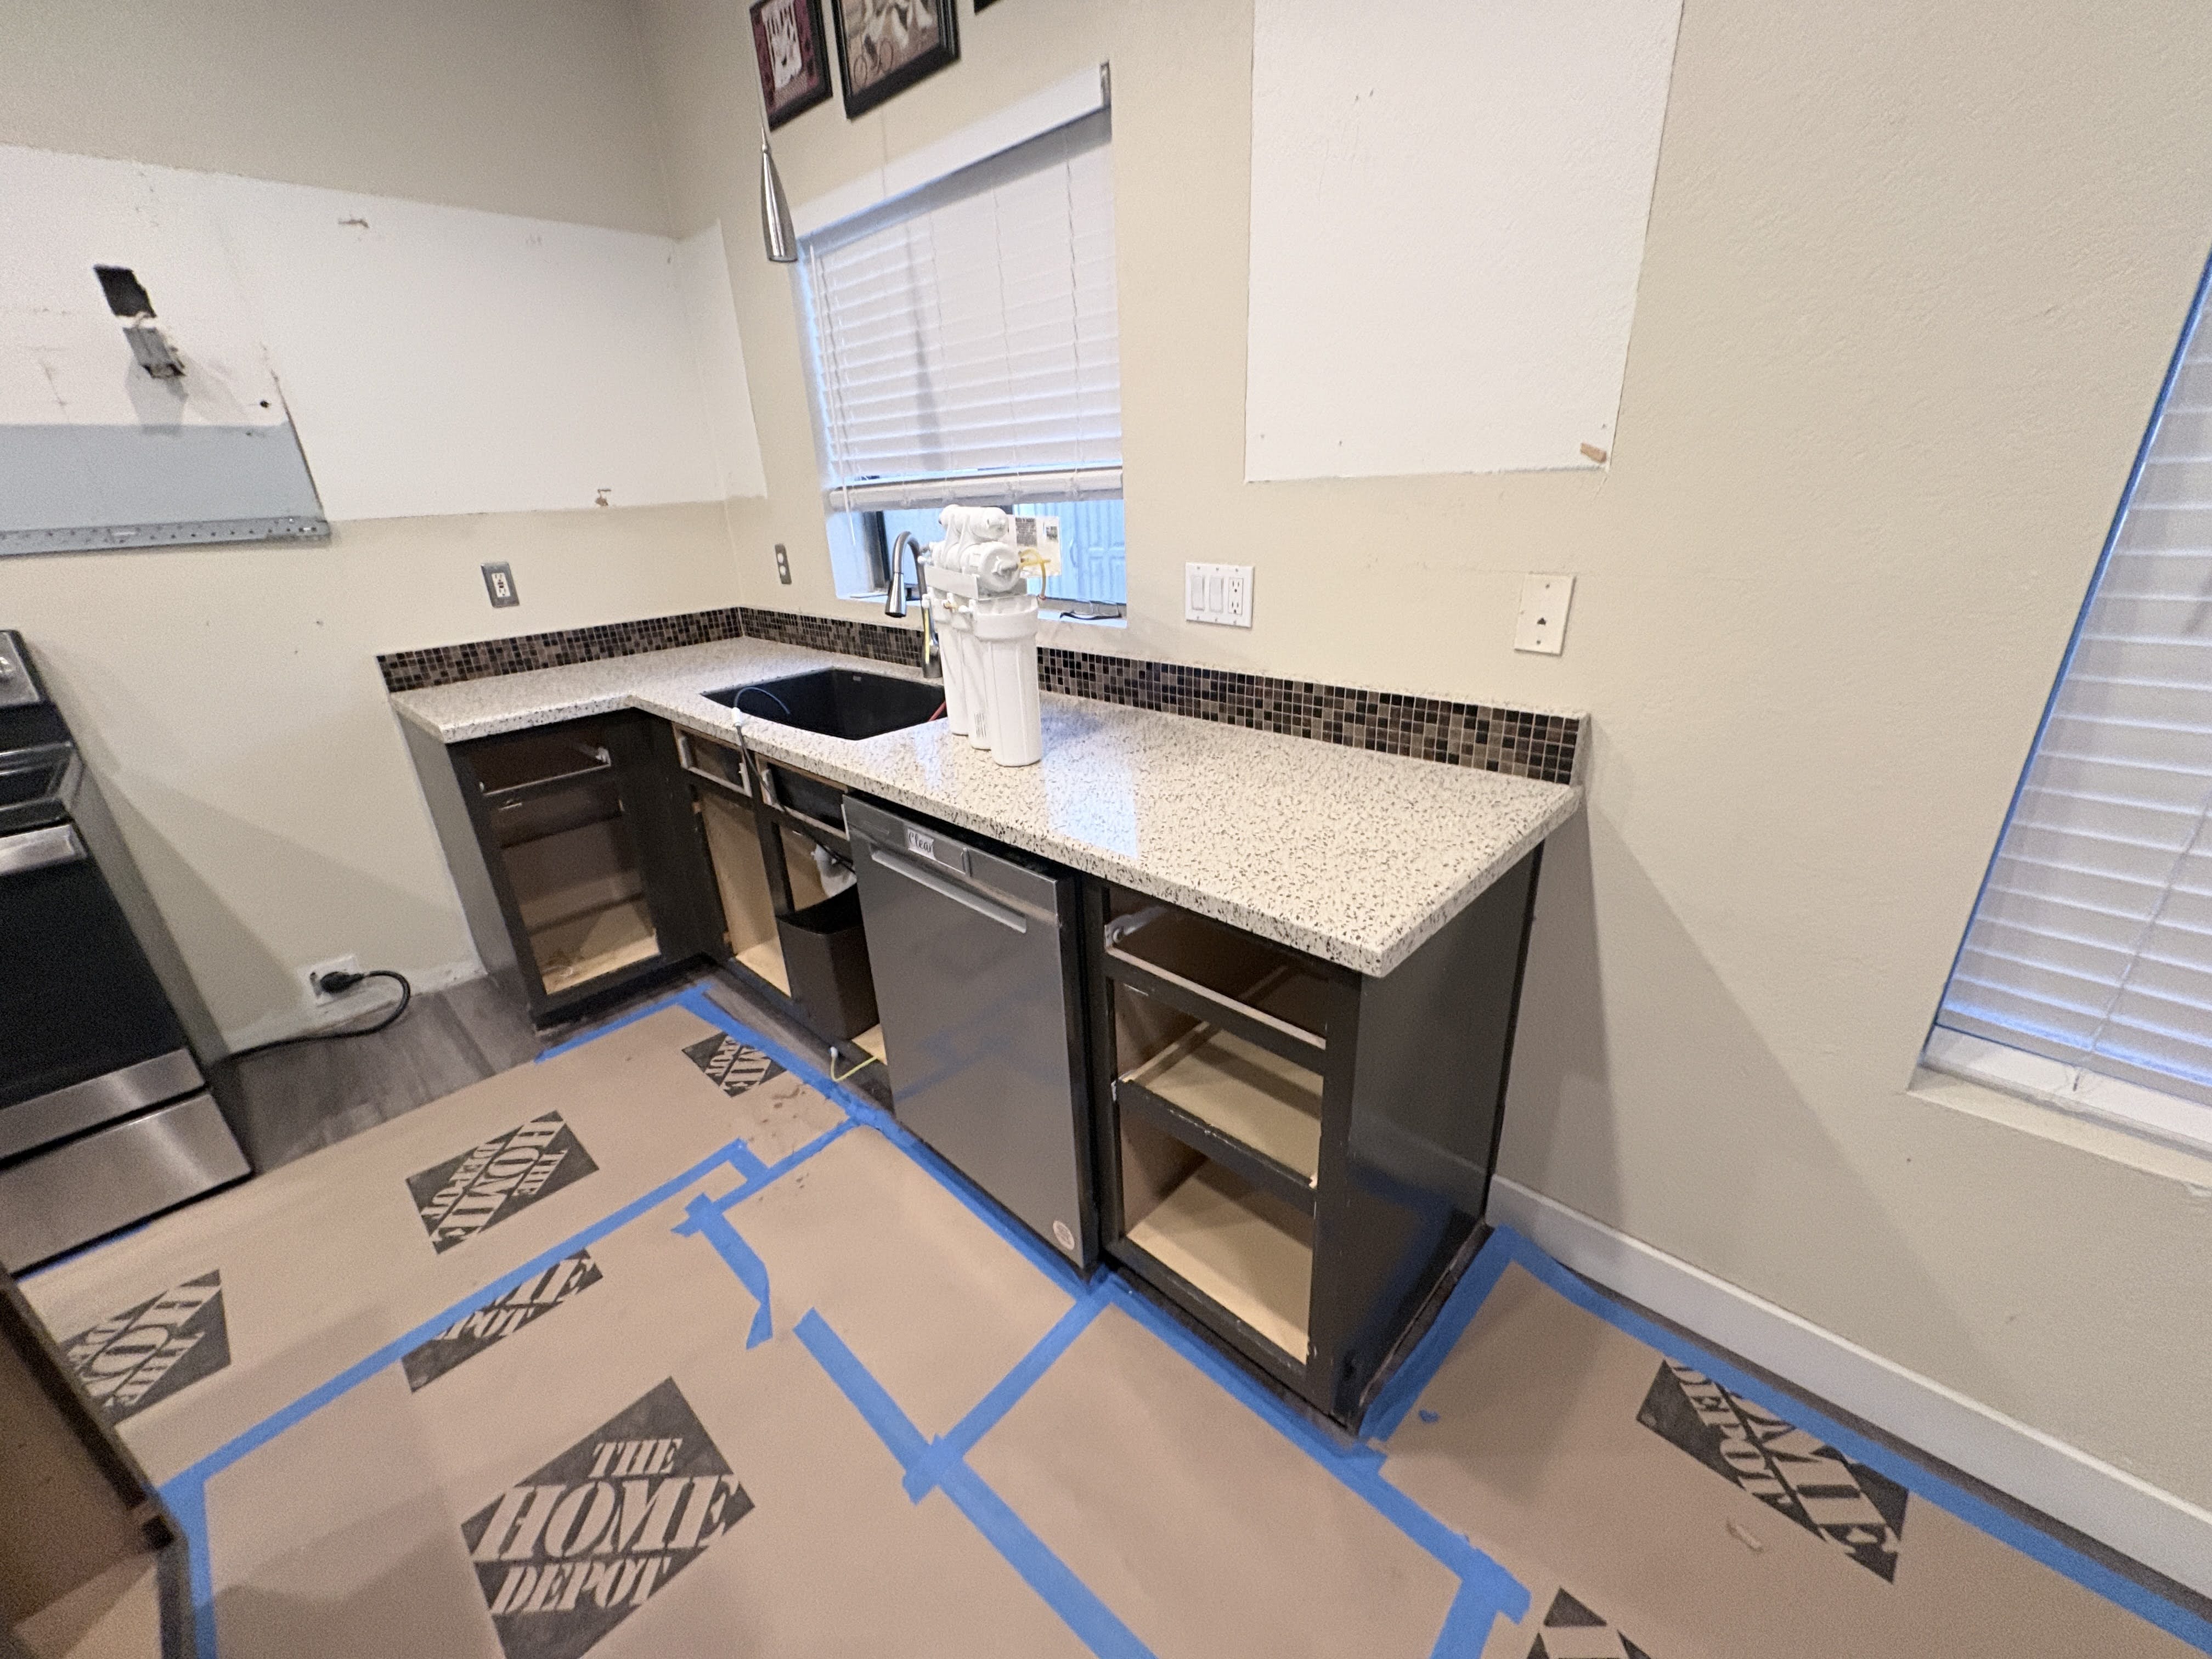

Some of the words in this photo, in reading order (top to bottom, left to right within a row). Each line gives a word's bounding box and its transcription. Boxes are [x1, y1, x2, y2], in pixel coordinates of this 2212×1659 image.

[421, 1142, 505, 1219] DEPOT
[429, 1120, 566, 1242] HOME
[512, 1149, 569, 1197] THE
[588, 1437, 683, 1479] THE
[470, 1474, 740, 1561] HOME
[490, 1555, 673, 1615] DEPOT
